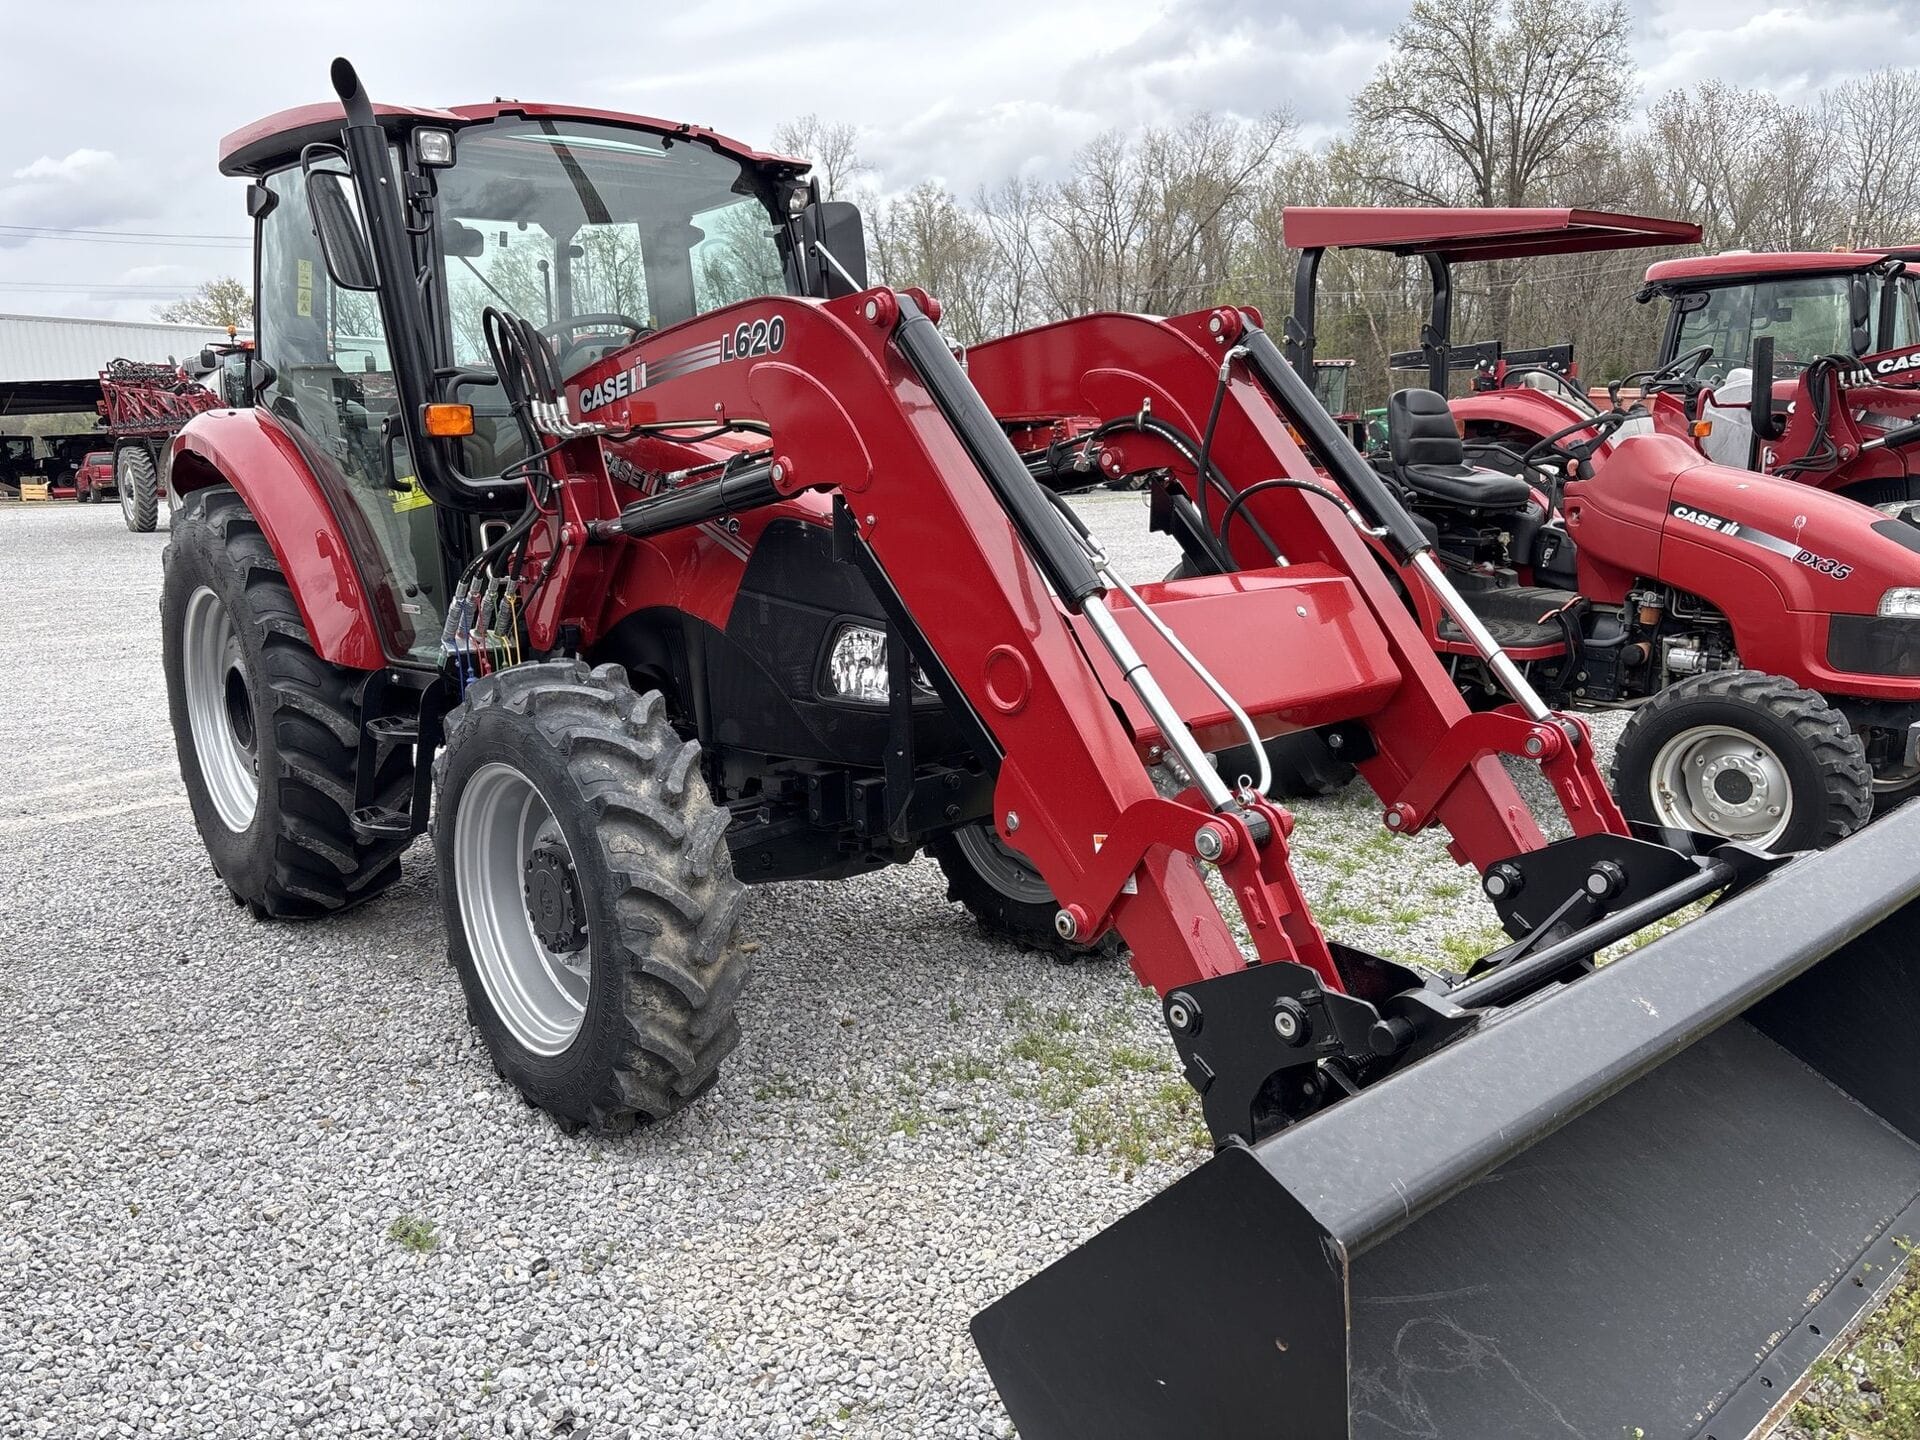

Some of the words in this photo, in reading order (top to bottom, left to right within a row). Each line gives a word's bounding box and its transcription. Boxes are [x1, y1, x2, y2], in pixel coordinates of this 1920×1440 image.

[580, 371, 628, 414] CASE
[721, 315, 786, 363] L620
[1673, 506, 1722, 533] CASE
[1795, 550, 1853, 582] DX35
